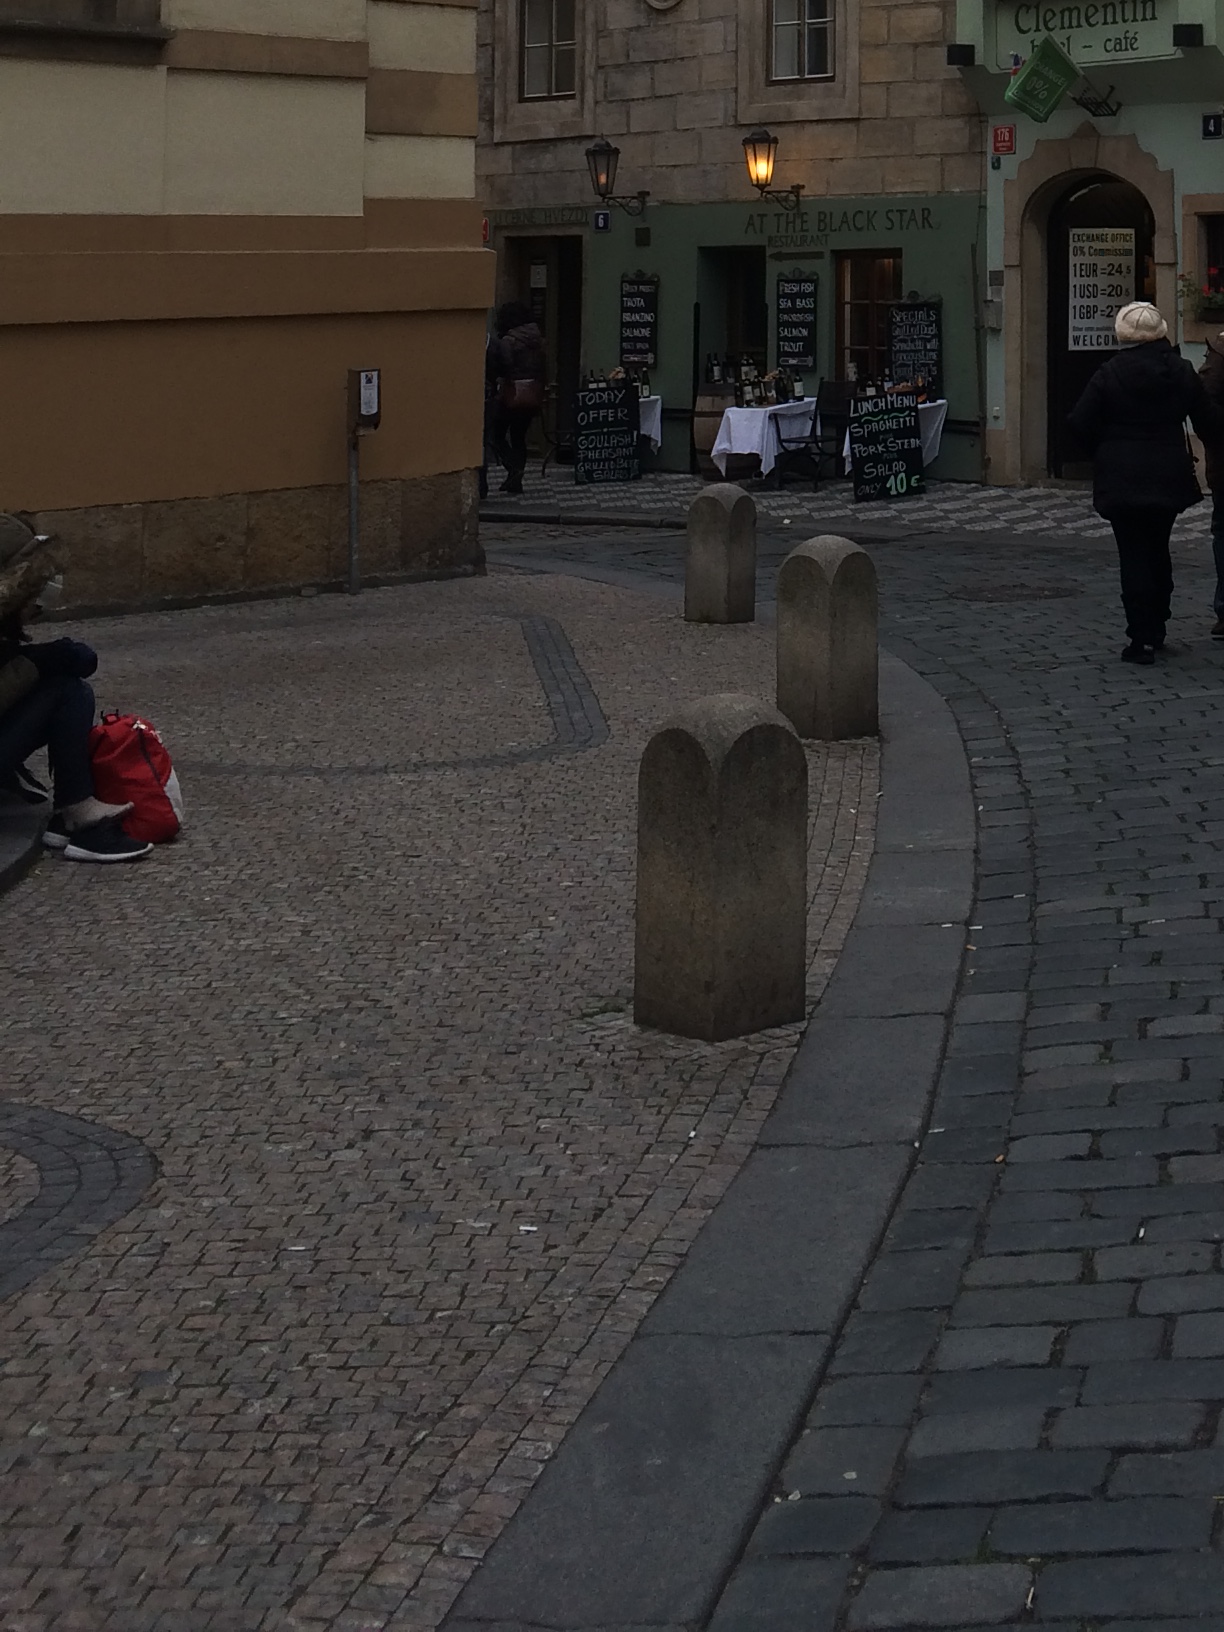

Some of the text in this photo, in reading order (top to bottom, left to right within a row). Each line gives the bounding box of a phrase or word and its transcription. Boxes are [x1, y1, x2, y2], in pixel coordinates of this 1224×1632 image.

[1103, 30, 1139, 53] café
[1026, 76, 1048, 100] 0%
[1208, 118, 1215, 133] 4
[997, 128, 1010, 142] 176
[597, 214, 605, 228] 6
[744, 207, 934, 235] AT THE BLACK STAR
[767, 234, 830, 248] RESTAURANT
[1072, 232, 1134, 243] EXCHANGE OFFICE
[1072, 245, 1133, 257] 0% Commission
[779, 281, 815, 295] FRESH FISH
[623, 297, 646, 308] TROTA
[779, 297, 815, 309] SEA BASS
[622, 312, 655, 323] BRANZINO
[622, 327, 652, 338] SALMONE
[778, 326, 809, 337] SALMON
[779, 341, 804, 352] TROUT
[1072, 334, 1119, 346] WELCOM
[577, 389, 626, 406] TODAY
[850, 393, 916, 417] LUNCH MENU
[578, 408, 630, 426] OFFER
[850, 412, 916, 438] SPAGHETTI
[577, 430, 637, 450] GOULASH!
[578, 447, 634, 461] PHEASANT
[852, 438, 921, 458] PORK STEAK
[863, 461, 906, 479] SALAD
[857, 483, 881, 499] ONLY
[886, 472, 907, 496] 10
